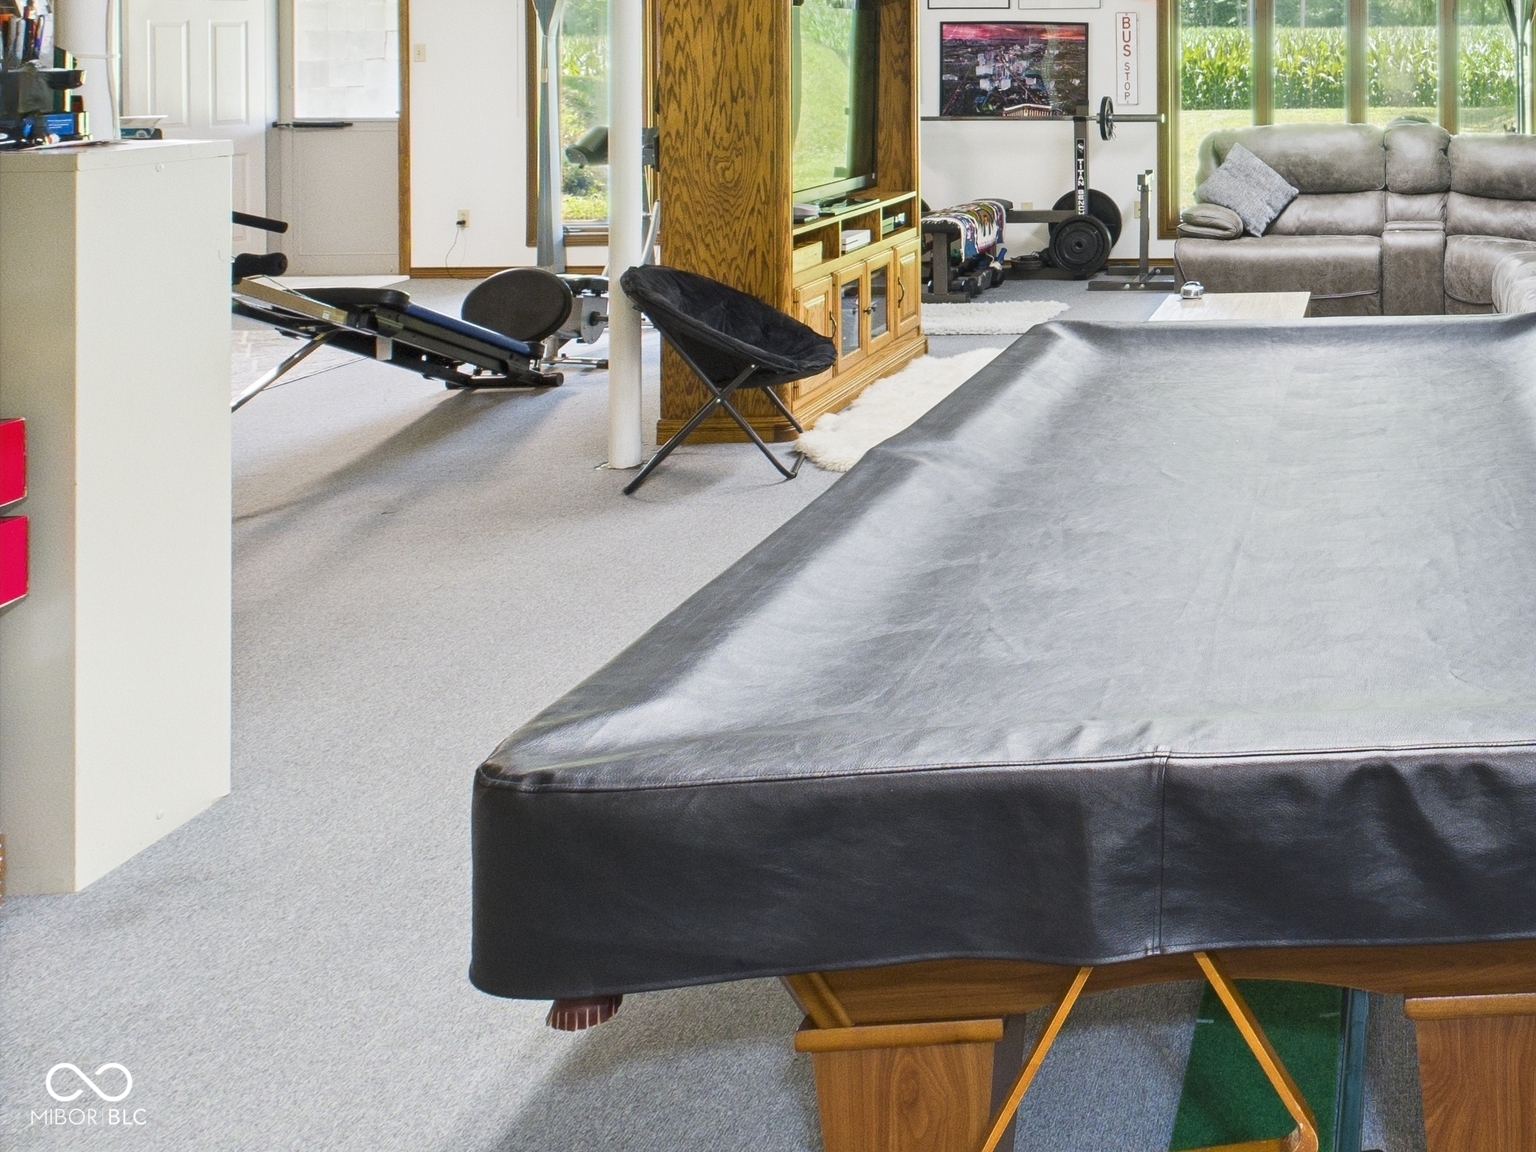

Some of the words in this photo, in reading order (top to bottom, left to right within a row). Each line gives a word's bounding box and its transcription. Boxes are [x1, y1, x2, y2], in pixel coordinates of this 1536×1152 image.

[1121, 16, 1132, 57] BUS
[1123, 61, 1131, 101] STOP
[1077, 158, 1085, 187] TITAN
